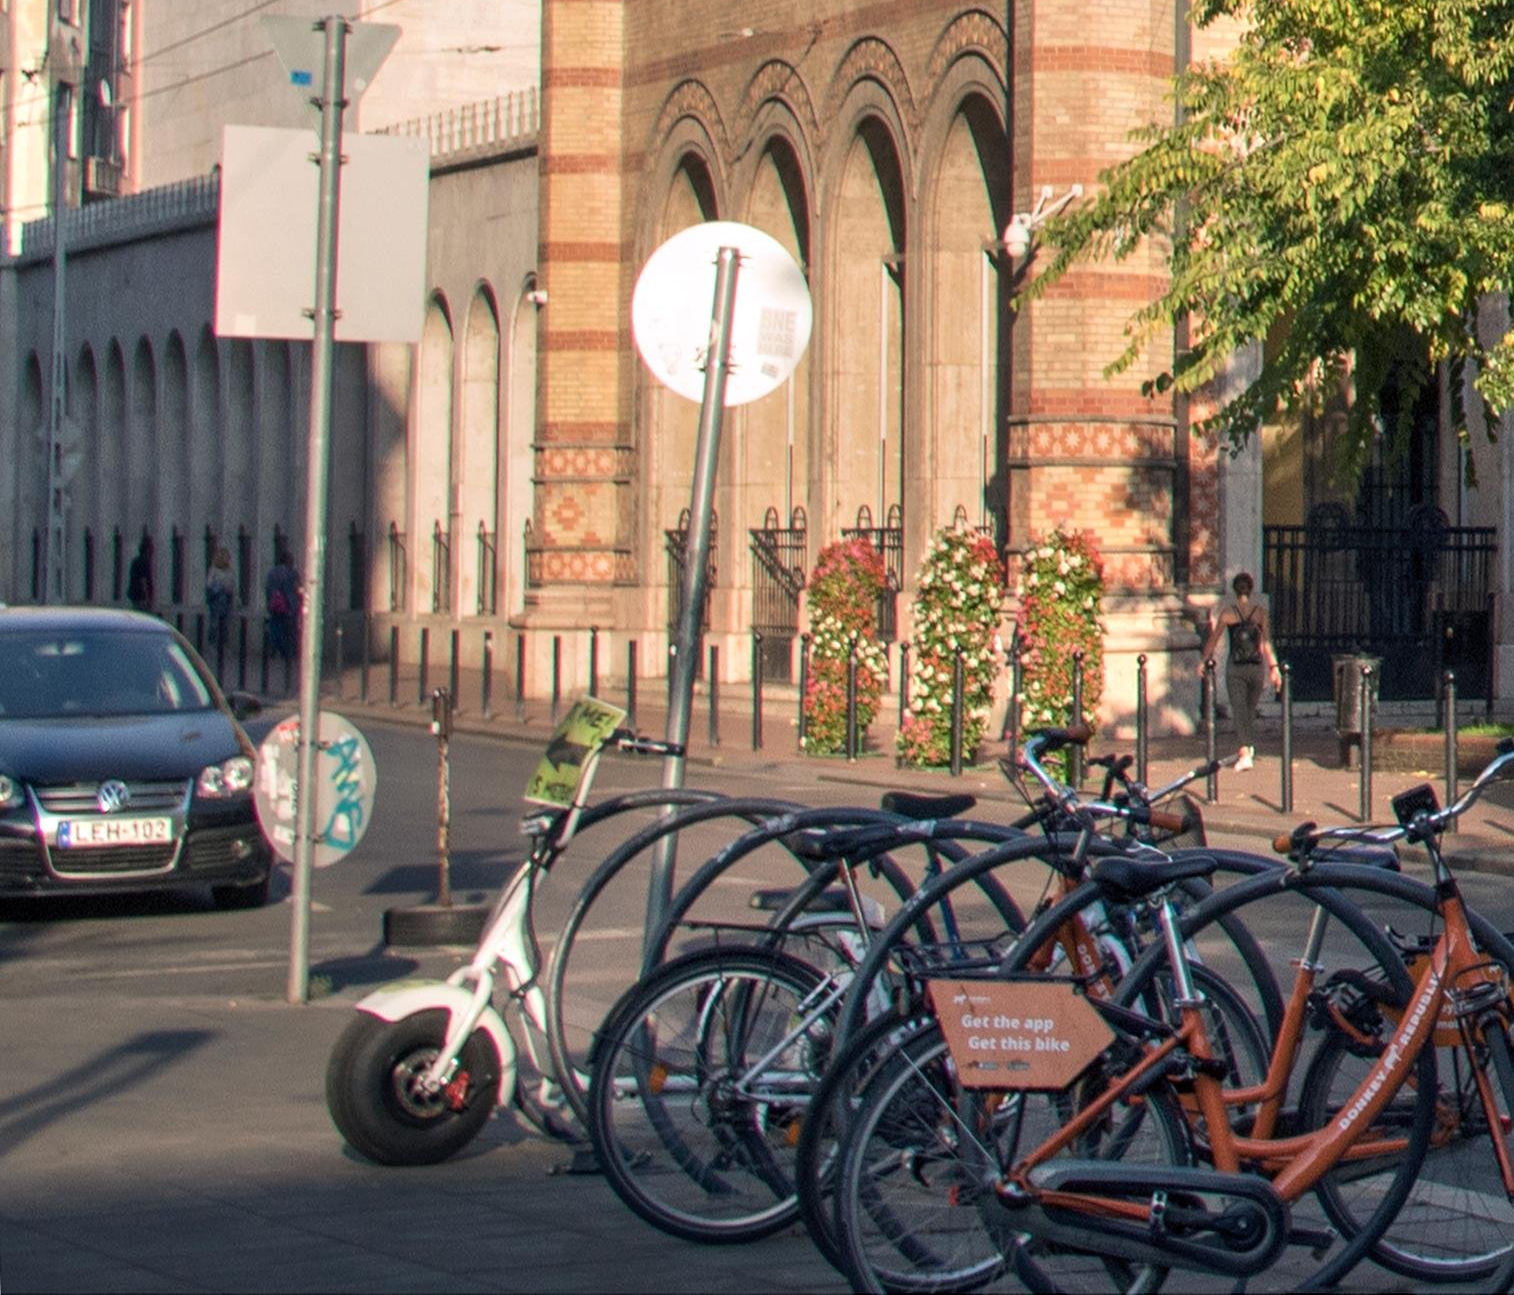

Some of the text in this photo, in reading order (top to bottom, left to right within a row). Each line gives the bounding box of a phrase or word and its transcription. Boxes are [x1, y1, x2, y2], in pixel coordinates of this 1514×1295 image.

[961, 1014, 1054, 1033] Get the app
[968, 1036, 1071, 1052] Get this bike
[1338, 1070, 1387, 1131] DONKEY
